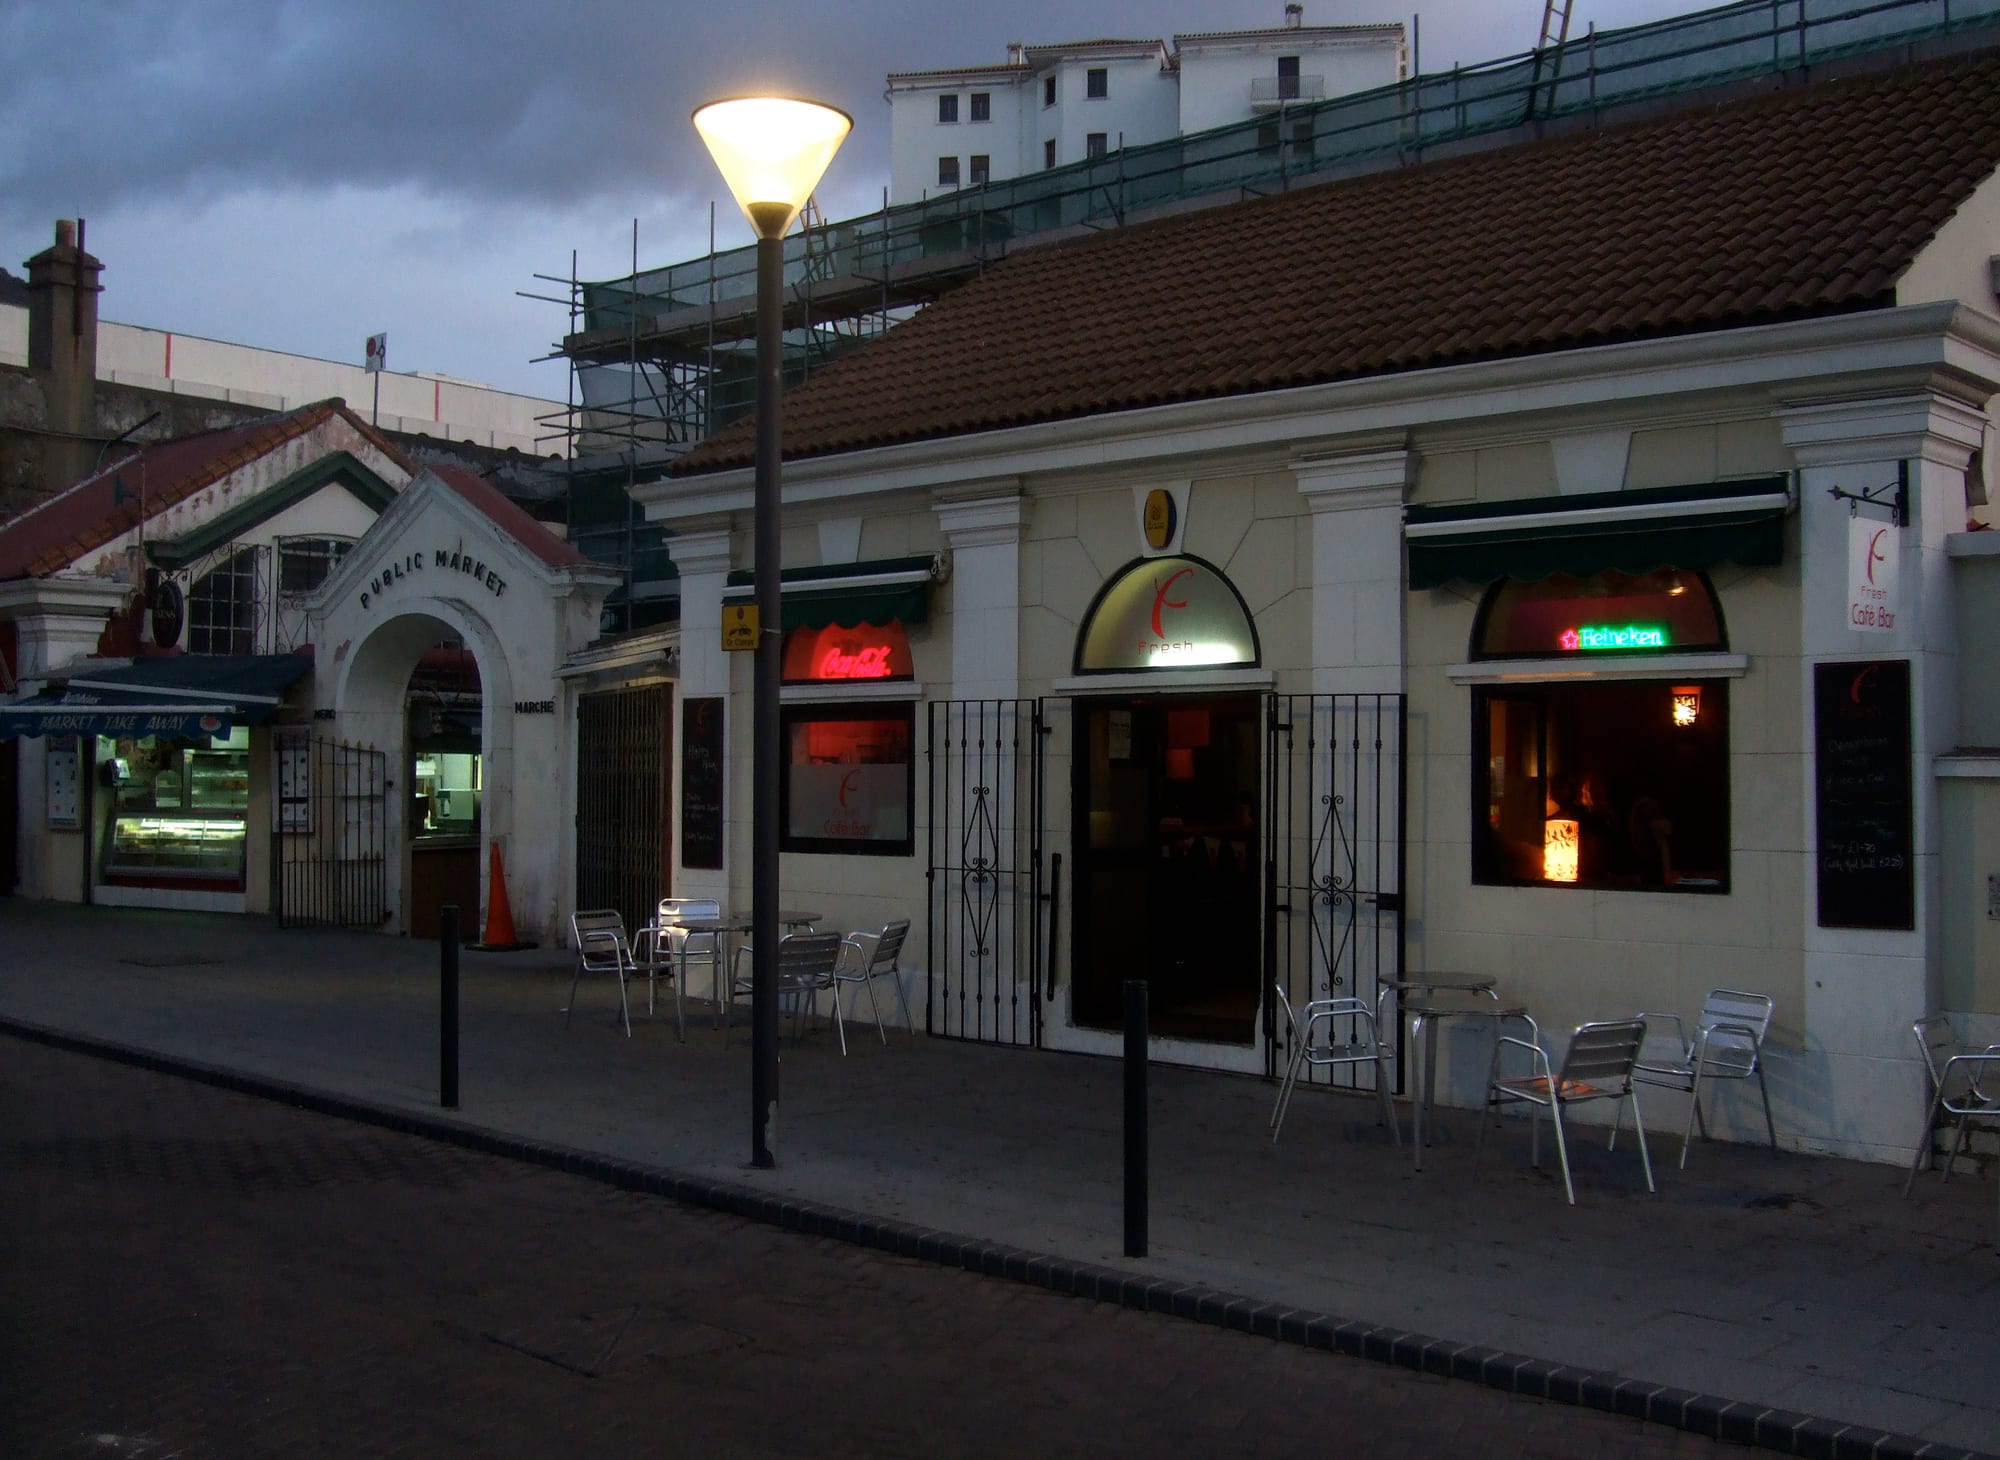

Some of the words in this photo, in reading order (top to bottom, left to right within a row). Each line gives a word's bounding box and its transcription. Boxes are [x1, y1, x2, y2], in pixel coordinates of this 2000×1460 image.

[360, 553, 423, 609] PUBLIC
[436, 550, 507, 597] MARKET
[1878, 606, 1895, 628] Bar
[1583, 629, 1664, 646] Heineken
[1138, 640, 1193, 656] Fresh
[40, 715, 96, 730] MARKET
[104, 715, 136, 730] TAKE
[144, 716, 190, 730] AWAY
